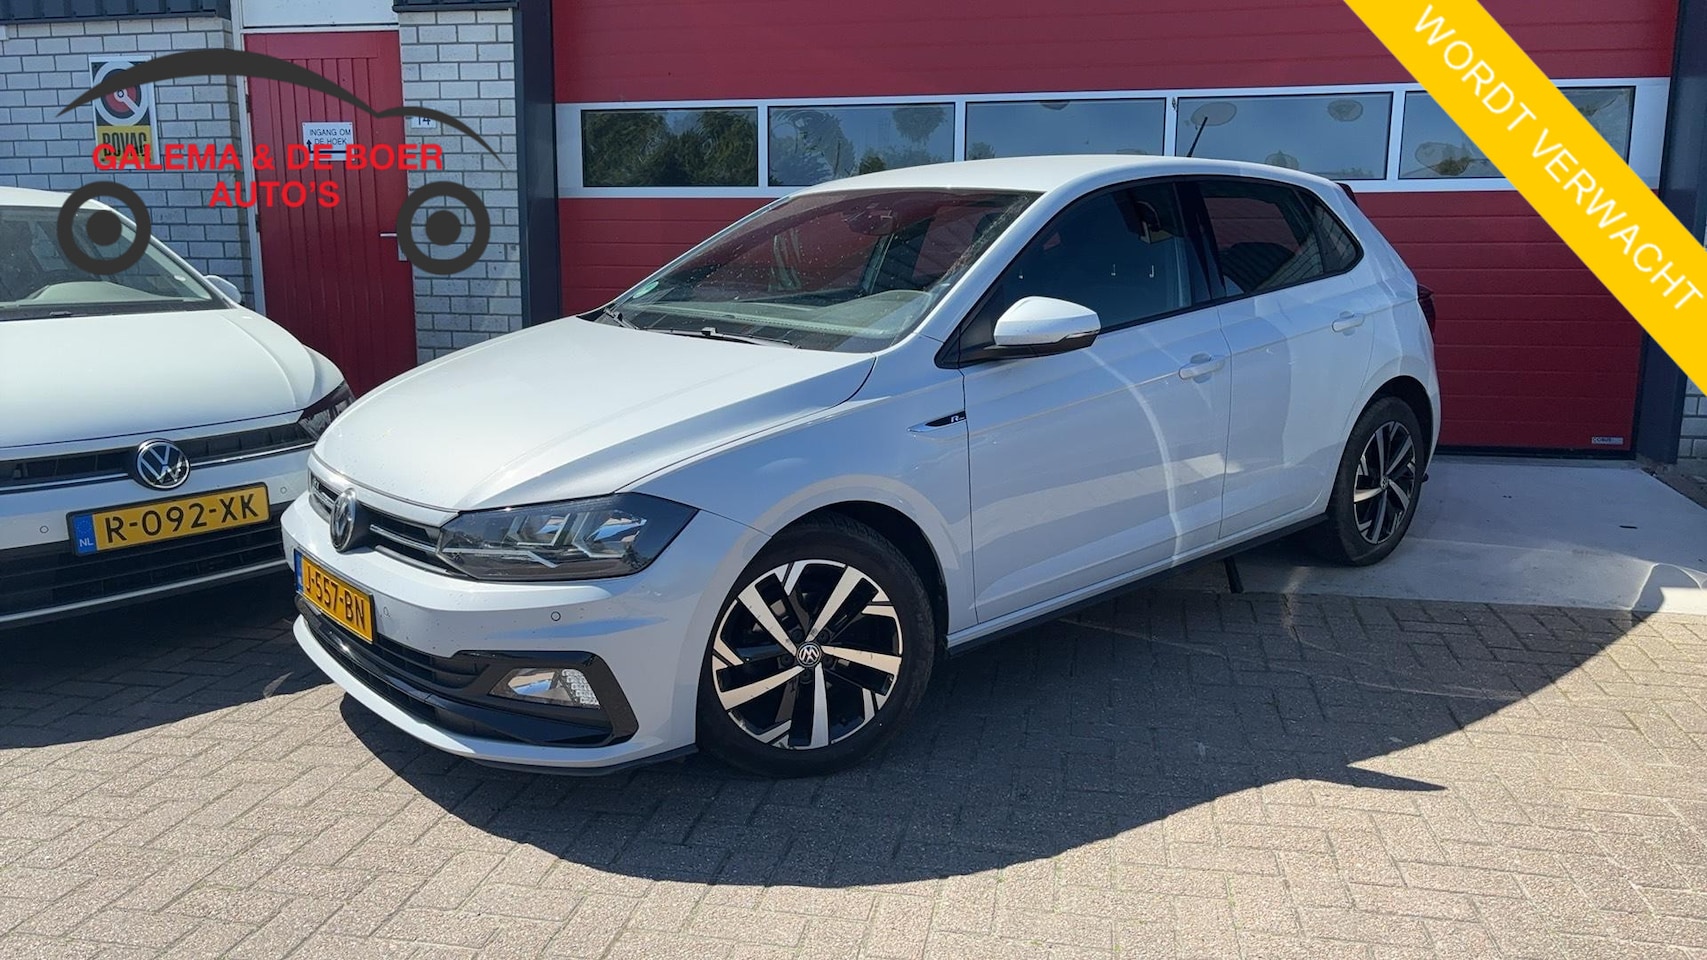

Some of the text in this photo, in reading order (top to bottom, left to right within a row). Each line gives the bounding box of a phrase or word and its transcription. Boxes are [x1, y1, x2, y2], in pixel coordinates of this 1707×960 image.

[309, 128, 352, 137] INGANG OM
[314, 137, 348, 146] DE HOEK
[104, 493, 259, 544] R-092-XK
[79, 538, 94, 548] NL
[305, 566, 368, 632] J-557-BN
